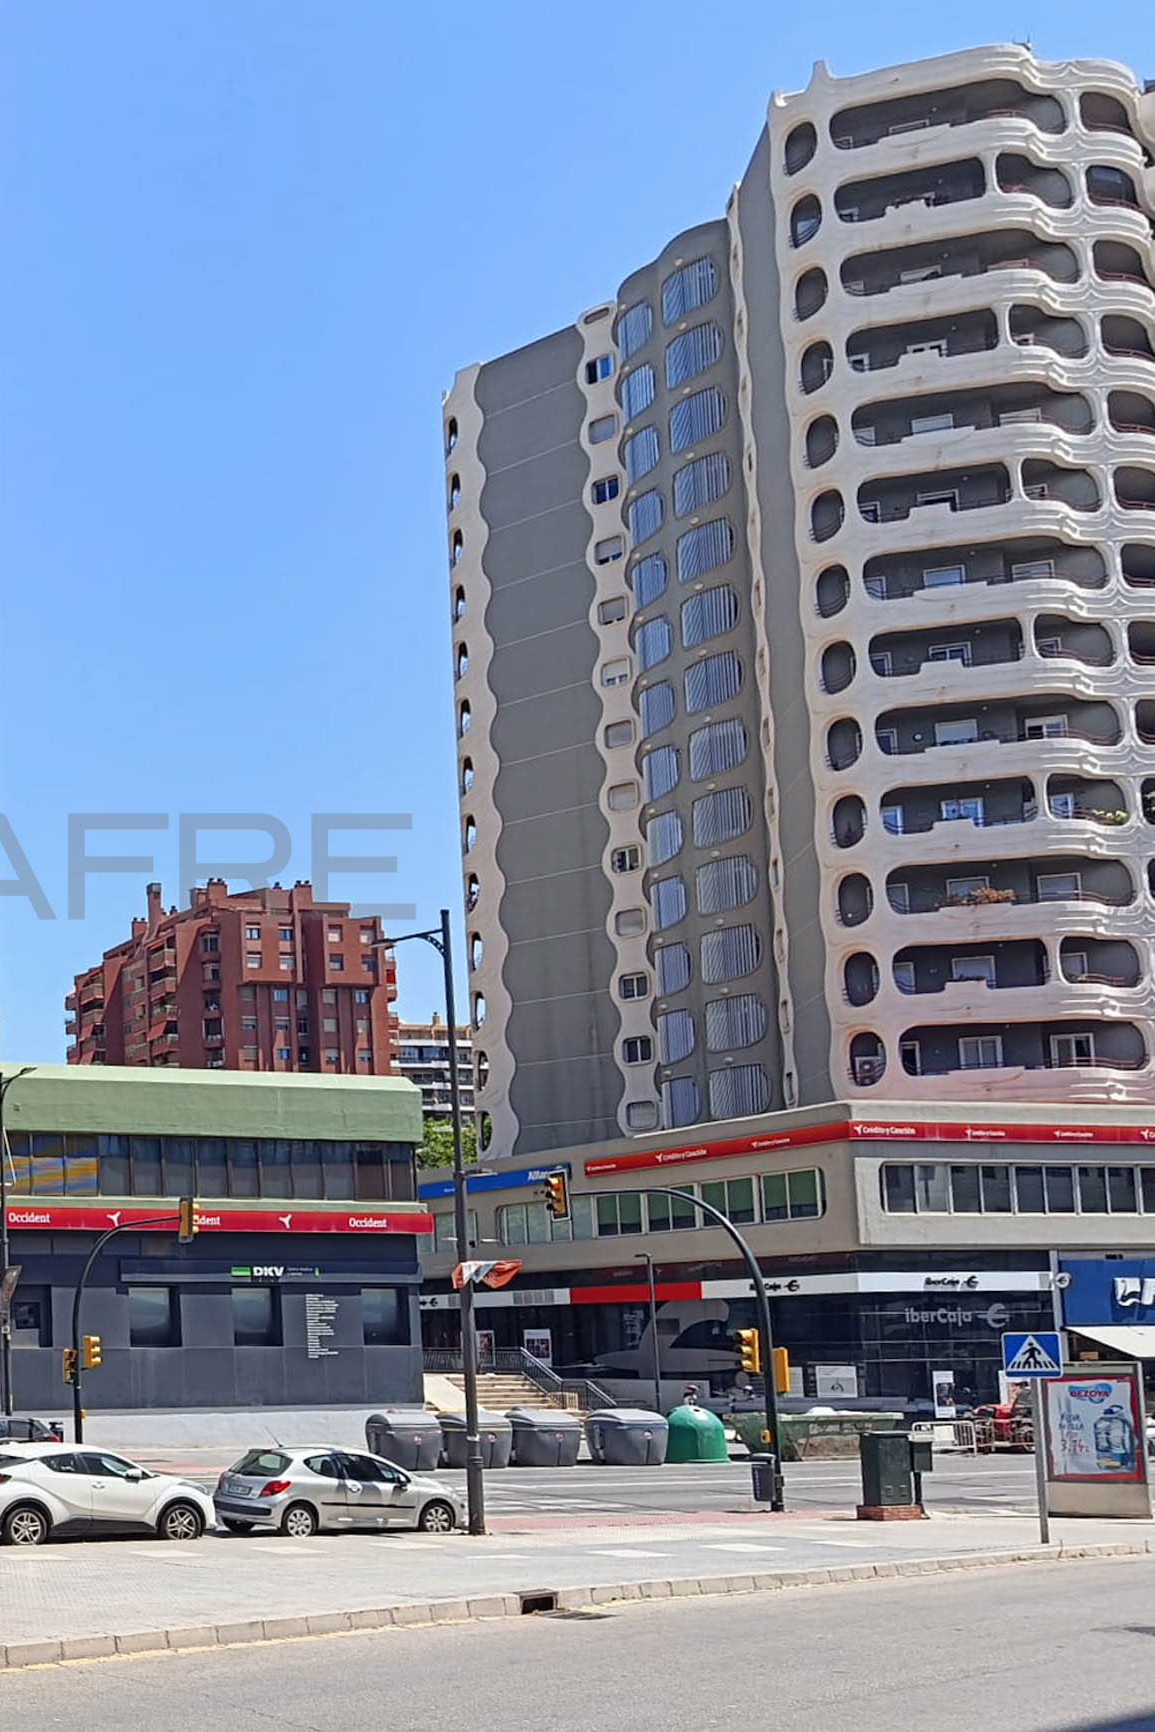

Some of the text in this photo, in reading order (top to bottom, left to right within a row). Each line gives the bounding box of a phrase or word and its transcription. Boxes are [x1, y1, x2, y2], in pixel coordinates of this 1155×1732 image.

[8, 1211, 51, 1223] Occident
[349, 1217, 387, 1228] Occident
[252, 1266, 284, 1277] DKV
[905, 1307, 973, 1327] iberCaja
